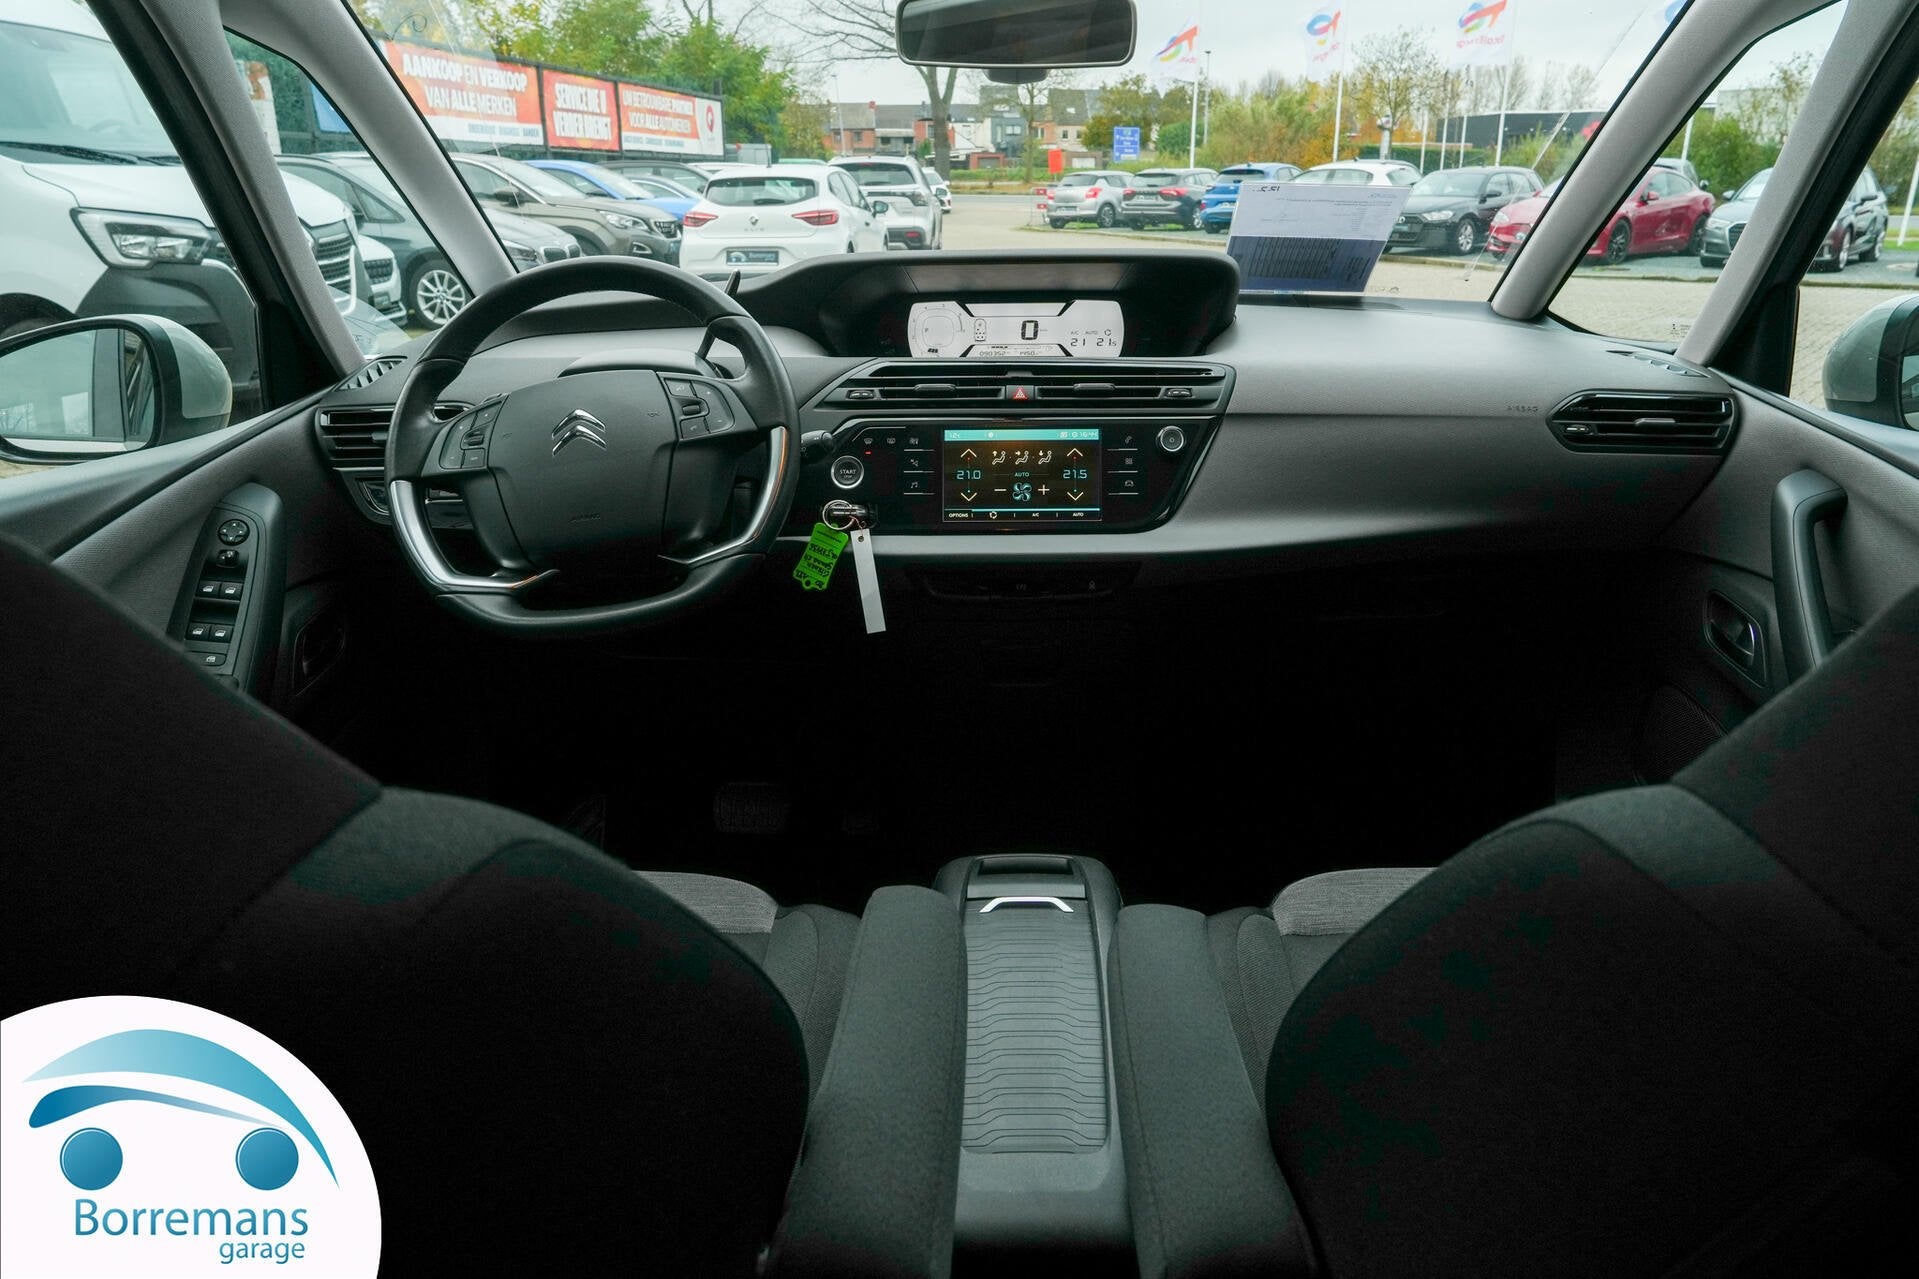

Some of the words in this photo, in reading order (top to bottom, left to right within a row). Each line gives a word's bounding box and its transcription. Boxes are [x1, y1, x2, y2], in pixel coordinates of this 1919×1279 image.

[402, 53, 464, 82] AANKOOP
[464, 64, 478, 86] EN
[479, 66, 528, 92] VERKOOP
[424, 85, 450, 109] VAN
[451, 88, 478, 113] ALLE
[478, 93, 517, 117] MERKEN
[1020, 319, 1040, 341] 0
[956, 469, 981, 480] 21.0
[1062, 468, 1088, 480] 21.5
